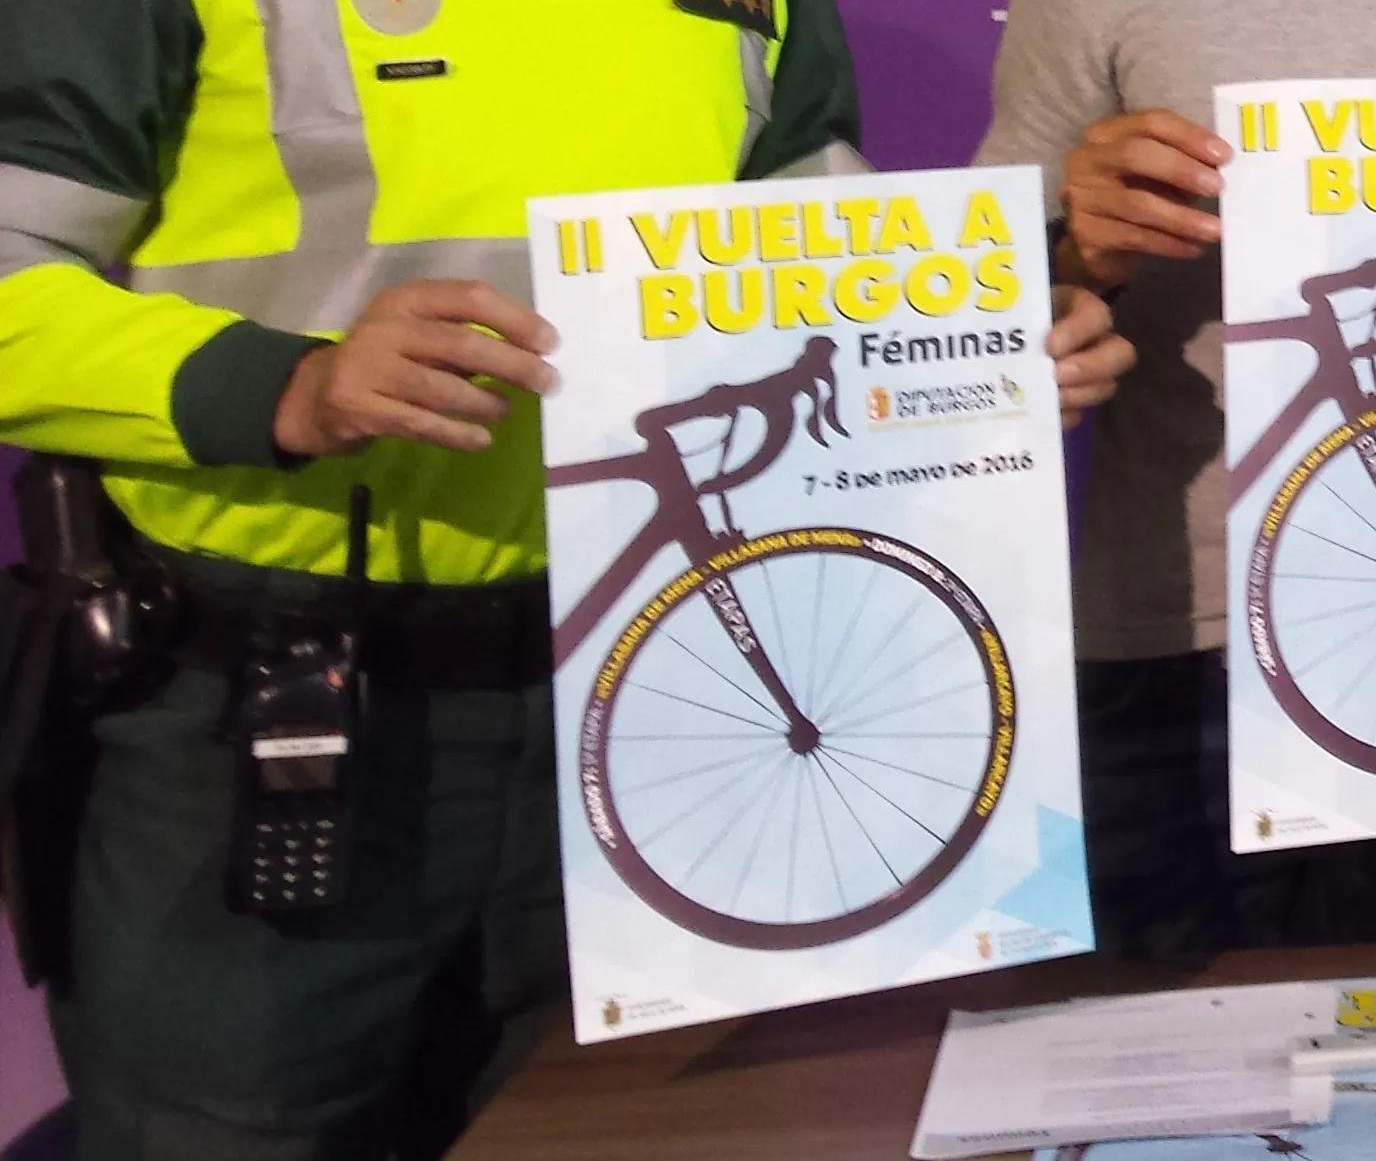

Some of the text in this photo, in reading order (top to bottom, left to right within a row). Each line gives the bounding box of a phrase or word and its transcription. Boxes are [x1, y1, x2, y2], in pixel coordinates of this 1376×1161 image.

[1239, 101, 1279, 152] II
[555, 189, 1013, 275] II VUELTA A
[637, 247, 1023, 340] BURGOS
[858, 326, 1026, 368] Féminas
[898, 396, 998, 419] DE BURGOS
[982, 451, 1033, 473] 2016
